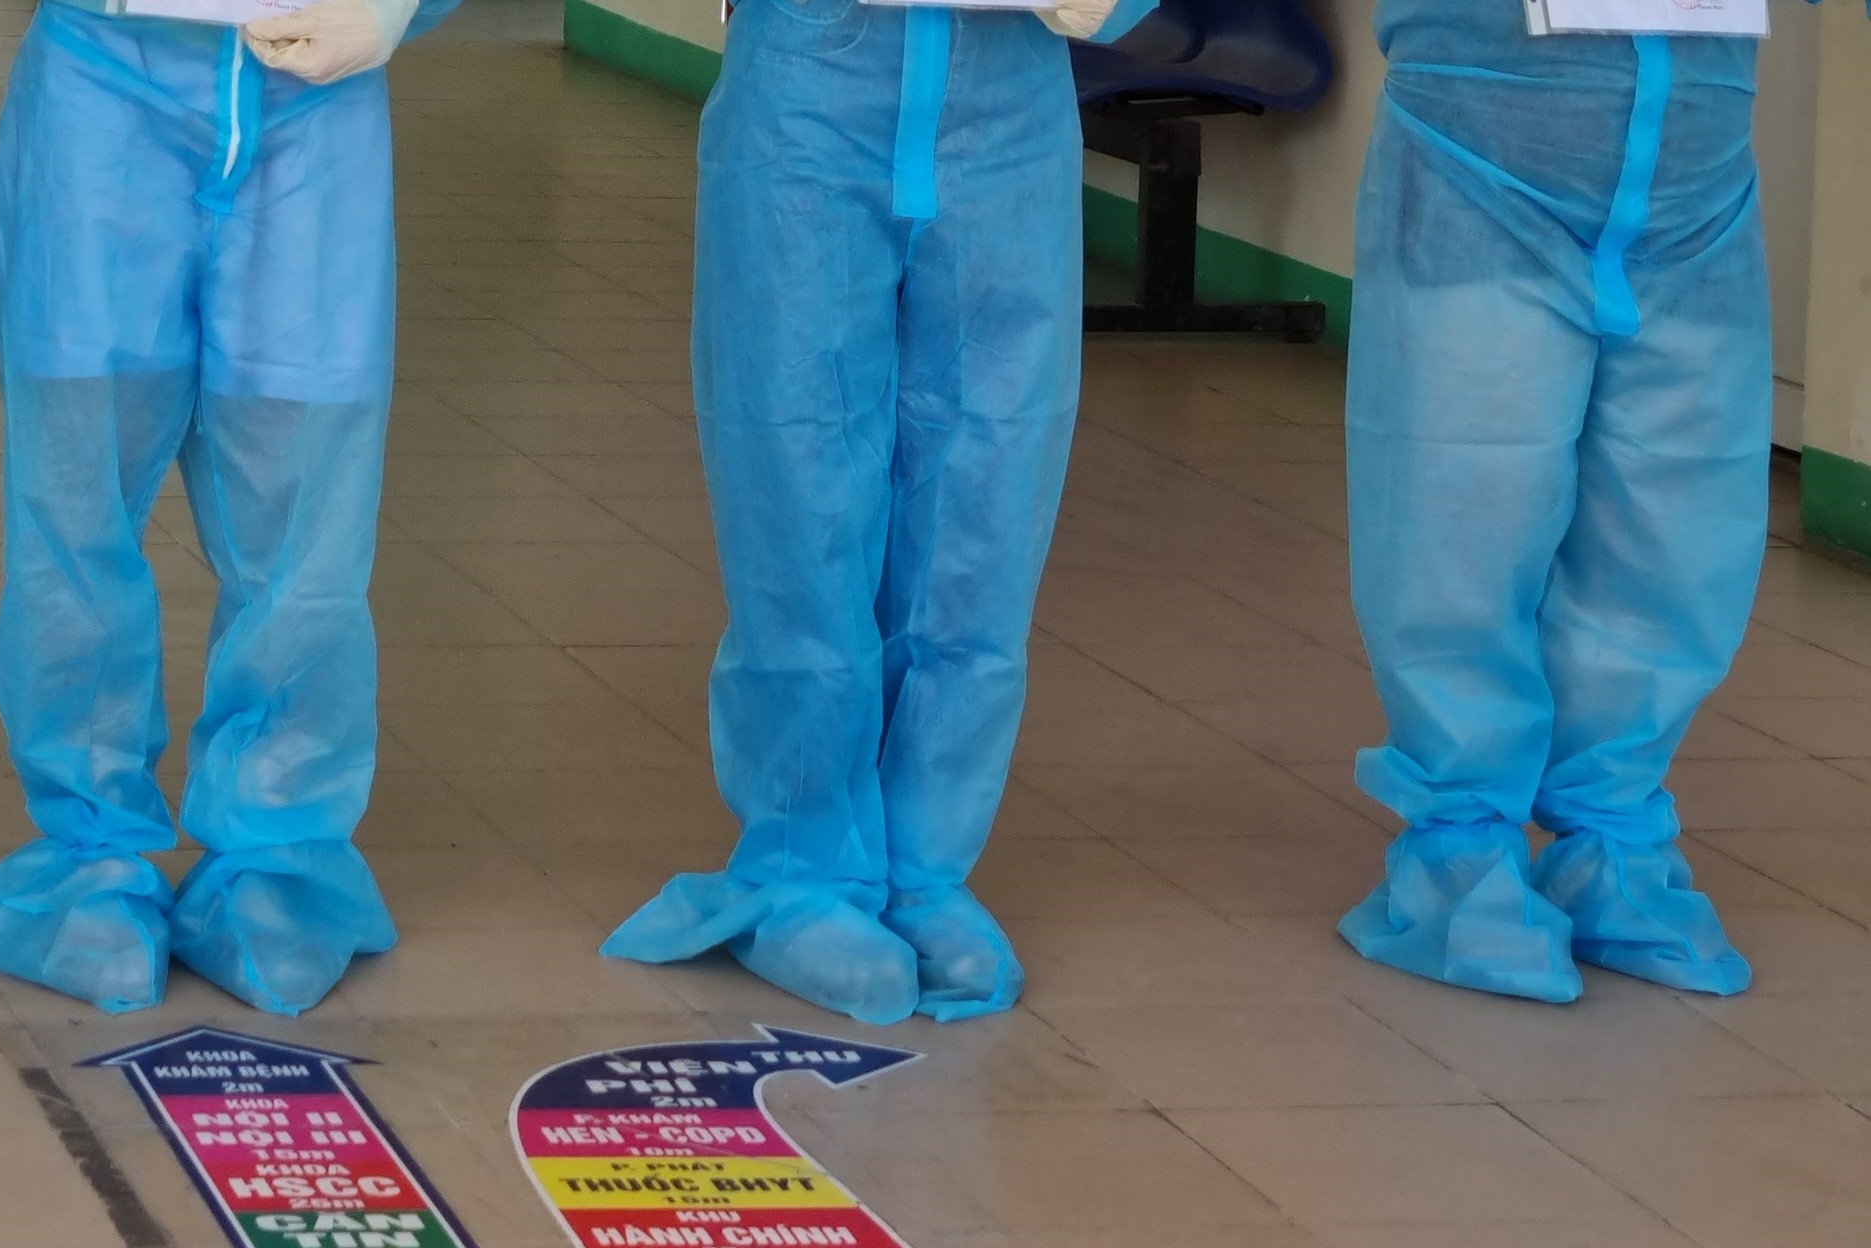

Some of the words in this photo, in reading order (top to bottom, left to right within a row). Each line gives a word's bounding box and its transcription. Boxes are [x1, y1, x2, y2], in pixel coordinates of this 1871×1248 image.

[186, 1050, 257, 1062] KHOA
[153, 1064, 233, 1078] KHÁM
[239, 1064, 310, 1079] BỆNH
[603, 1058, 758, 1076] VIỆN
[221, 1081, 264, 1093] 2m
[585, 1076, 697, 1094] PHÍ
[225, 1099, 289, 1110] KHOA
[650, 1096, 718, 1107] 2m
[192, 1111, 289, 1127] NỘI
[305, 1112, 343, 1126] II
[609, 1112, 703, 1125] KHÁM
[195, 1129, 294, 1146] NỘI
[311, 1130, 368, 1144] III
[541, 1126, 625, 1144] HEN
[658, 1126, 767, 1144] COPD
[255, 1164, 351, 1175] KHOA
[647, 1162, 727, 1171] PHÁT
[228, 1176, 401, 1198] HSCC
[558, 1172, 700, 1193] THUỐC
[710, 1176, 815, 1192] BHYT
[676, 1211, 742, 1223] KHU
[591, 1224, 713, 1246] HÀNH
[723, 1225, 857, 1246] CHÍNH
